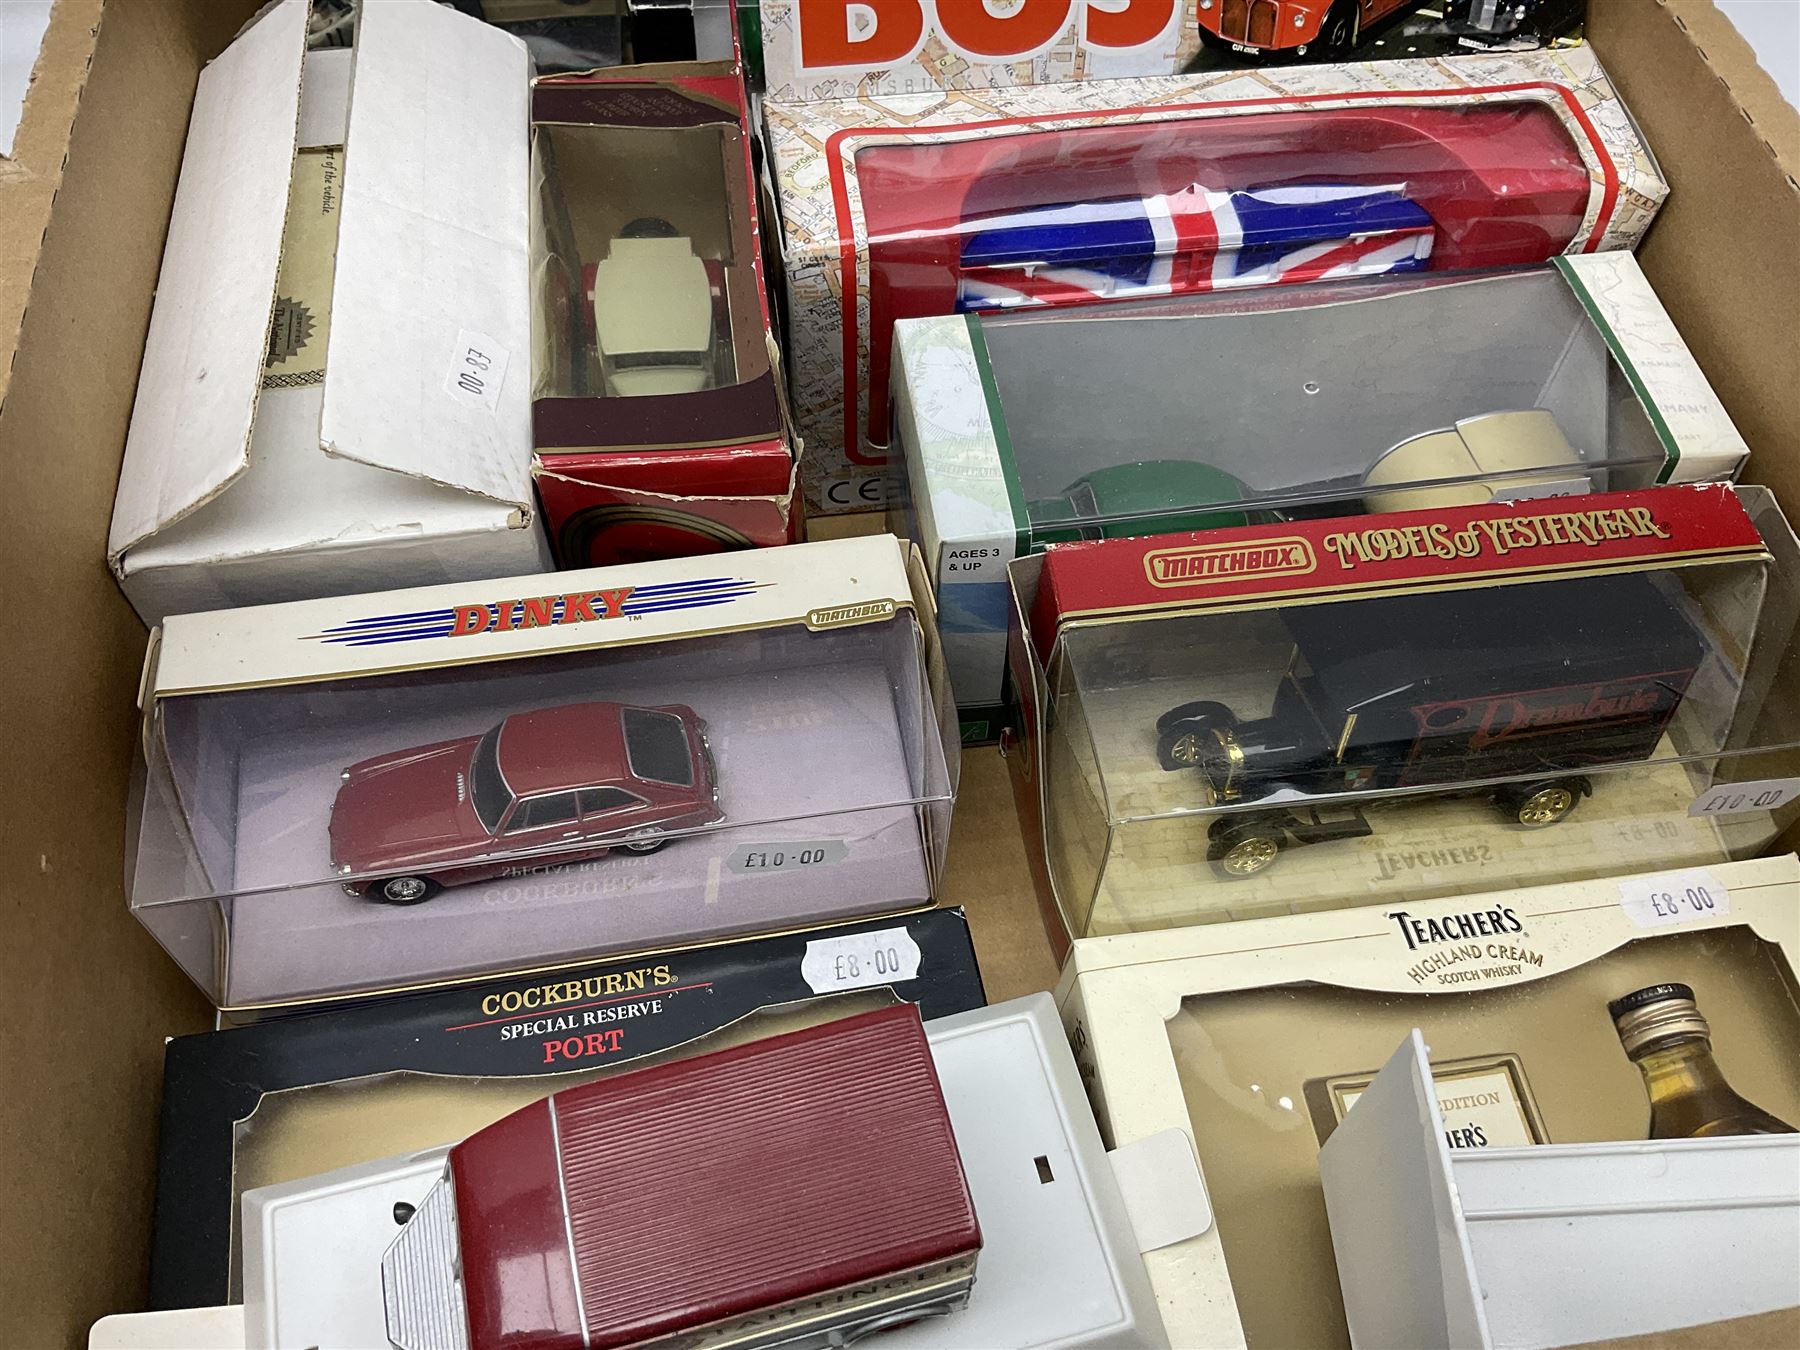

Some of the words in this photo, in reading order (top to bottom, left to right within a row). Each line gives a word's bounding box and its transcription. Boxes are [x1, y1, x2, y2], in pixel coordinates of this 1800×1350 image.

[320, 160, 333, 173] of
[325, 170, 338, 185] the
[784, 153, 819, 178] BEDFORD
[321, 182, 337, 216] vehicle.
[948, 549, 988, 560] AGES
[992, 547, 1000, 558] 3
[1322, 521, 1452, 569] MODELS
[1454, 523, 1483, 559] of
[1481, 506, 1668, 551] YESTERYEAR
[948, 563, 958, 571] &
[962, 562, 982, 571] UP
[1162, 548, 1296, 577] MATCHBOX
[448, 586, 637, 638] DINKY
[814, 602, 890, 625] MATCHBOX
[1468, 686, 1660, 749] Drambuie
[744, 849, 825, 868] £10.00
[1651, 885, 1715, 918] £8.00
[1388, 904, 1524, 951] TEACHER'S
[834, 946, 901, 981] £8.00
[1407, 943, 1483, 985] HIGHLAND
[1486, 943, 1544, 968] CREAM
[1437, 969, 1481, 985] SCOTCH
[1481, 963, 1523, 979] WHISKY
[482, 964, 672, 1017] COCKBURN'S
[500, 1015, 579, 1042] SPECIAL
[587, 999, 663, 1027] RESERVE
[543, 1029, 625, 1064] PORT
